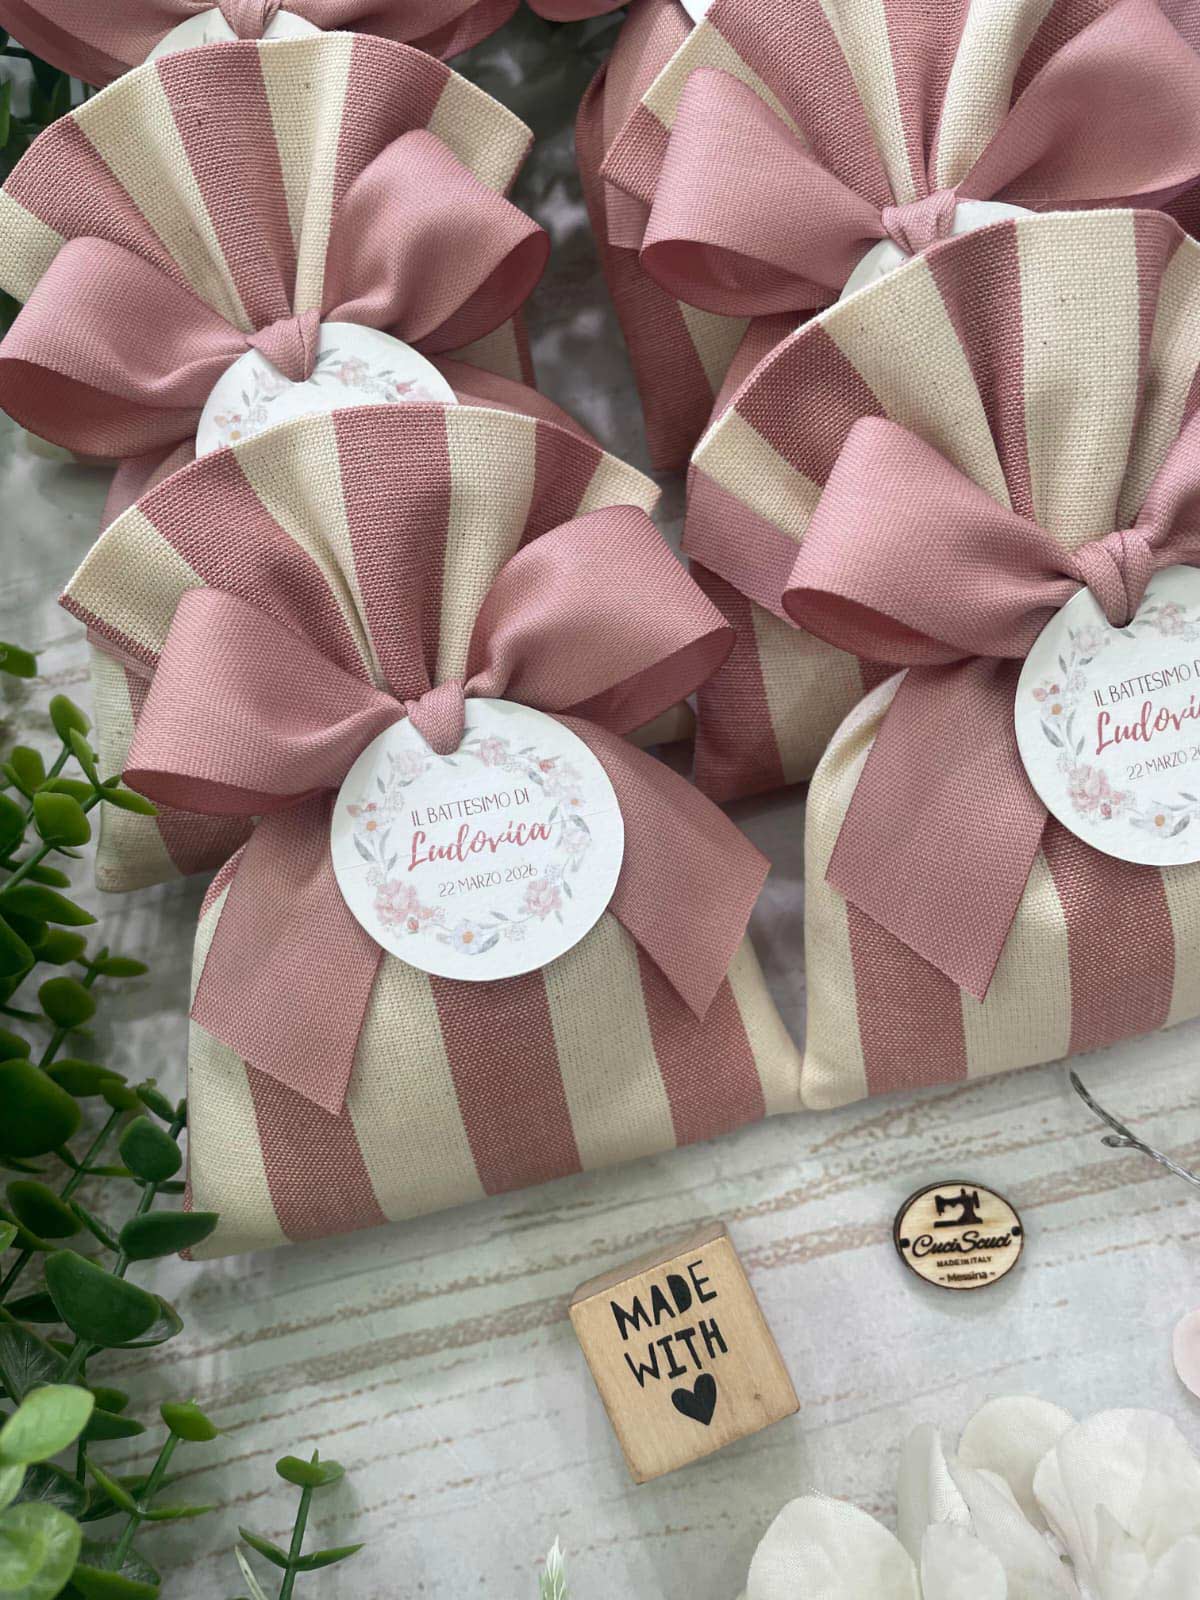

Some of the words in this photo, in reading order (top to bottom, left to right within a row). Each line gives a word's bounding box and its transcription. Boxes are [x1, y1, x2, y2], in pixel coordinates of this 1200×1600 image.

[1093, 688, 1108, 707] IL
[1110, 664, 1191, 703] BATTESIMO
[1096, 693, 1200, 755] Ludovi
[1127, 764, 1143, 781] 22
[1145, 750, 1188, 774] MARZO
[411, 809, 425, 827] IL
[427, 792, 511, 825] BATTESIMO
[514, 787, 529, 807] DI
[407, 820, 552, 872] Ludovica
[438, 882, 457, 898] 22
[458, 868, 502, 892] MARZO
[505, 863, 538, 883] 2026
[936, 1258, 960, 1267] MADE
[960, 1258, 969, 1266] IN
[970, 1256, 992, 1265] ITALY
[610, 1260, 718, 1341] MADE
[623, 1317, 729, 1388] WITH
